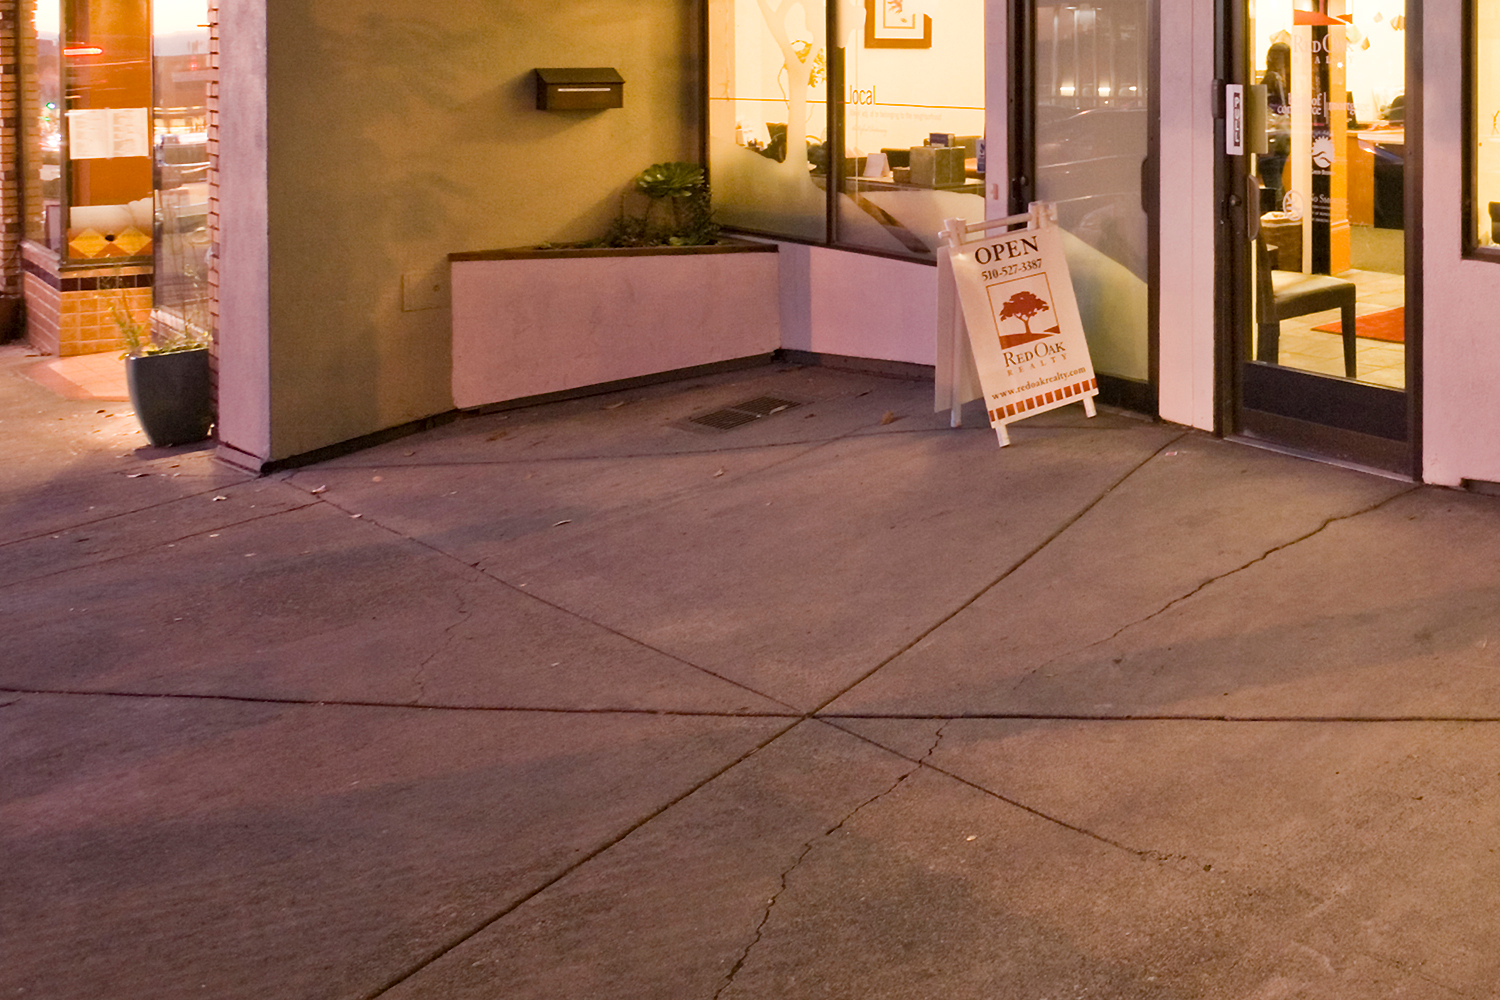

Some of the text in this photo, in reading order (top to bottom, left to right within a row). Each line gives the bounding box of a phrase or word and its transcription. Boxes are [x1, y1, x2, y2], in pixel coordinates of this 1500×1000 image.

[850, 85, 876, 105] local
[974, 236, 1039, 265] OPEN
[981, 258, 1042, 281] 510-527-3387
[1003, 341, 1066, 367] RED OAK
[1007, 353, 1069, 377] REALTY
[991, 366, 1087, 401] www.redoakrealty.com
